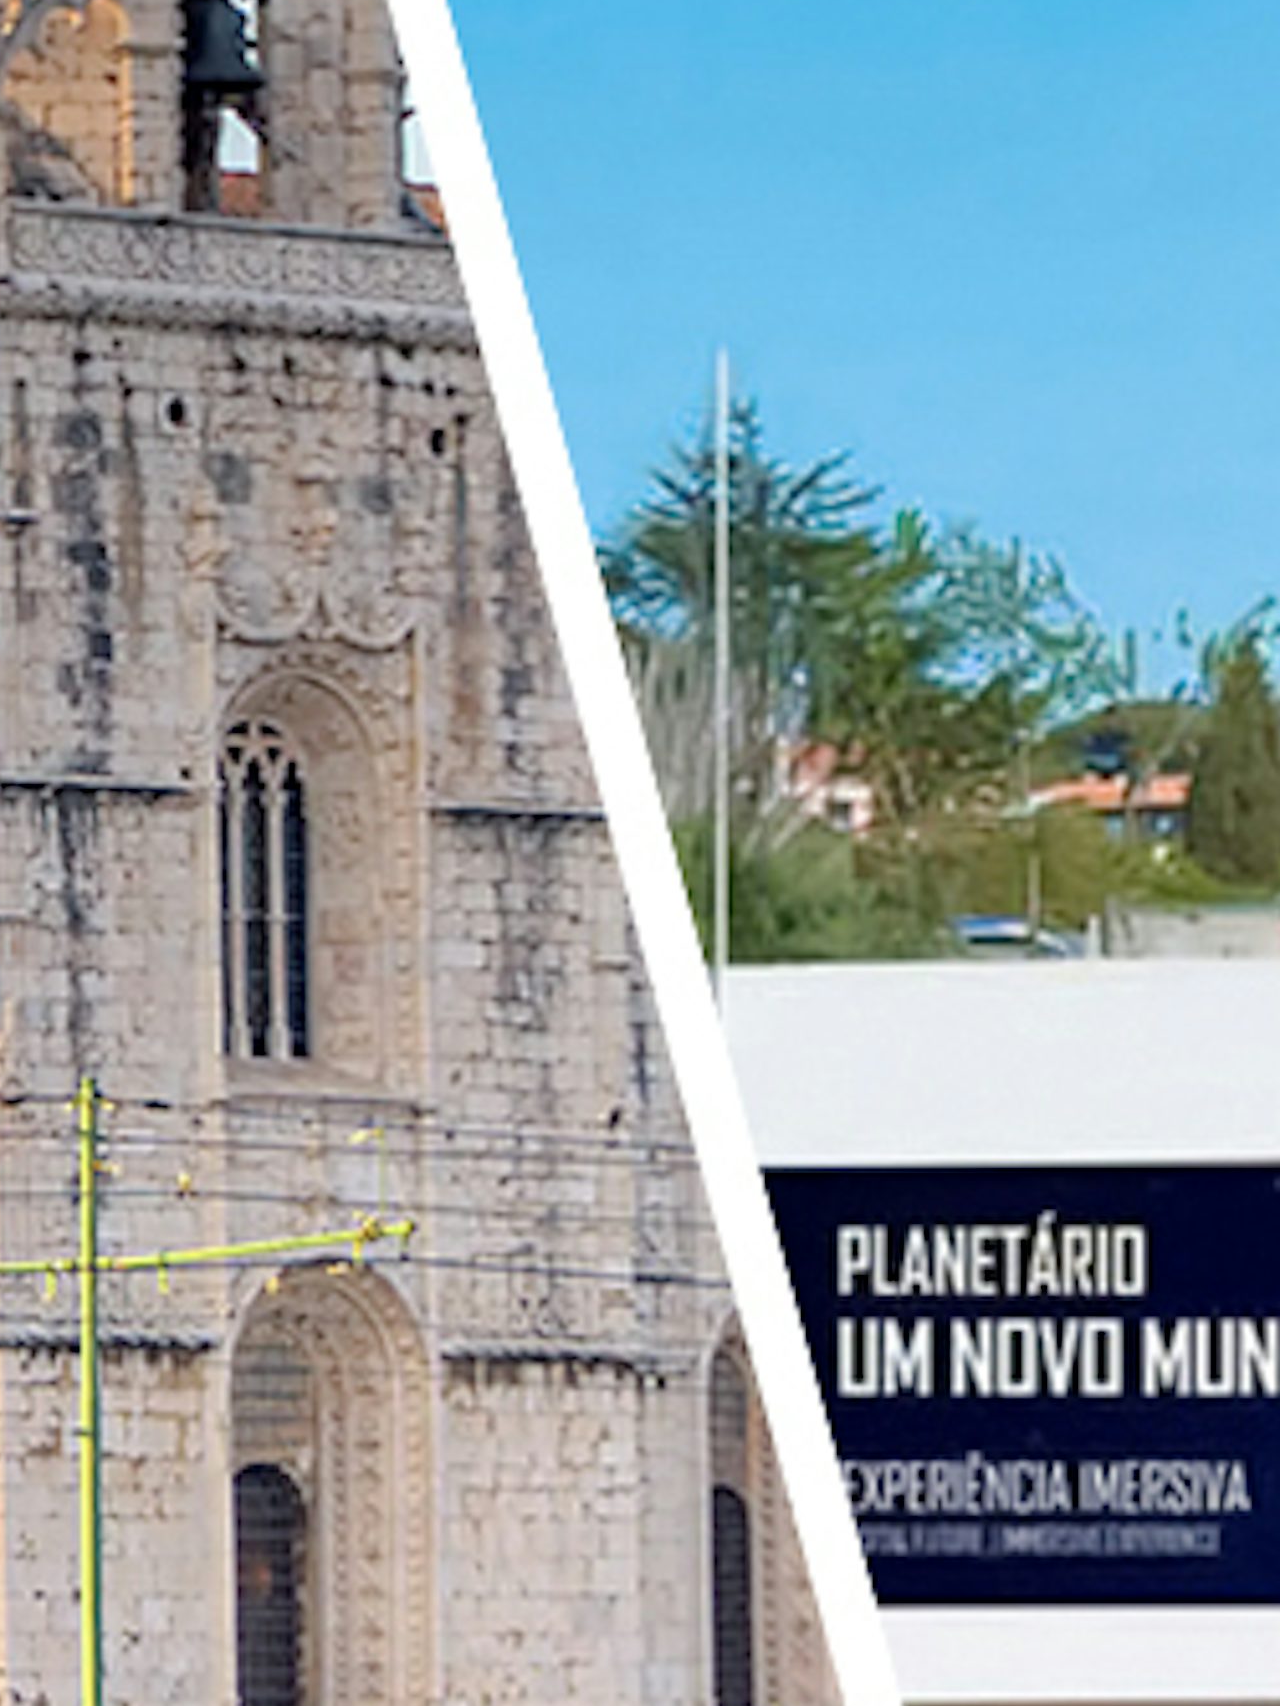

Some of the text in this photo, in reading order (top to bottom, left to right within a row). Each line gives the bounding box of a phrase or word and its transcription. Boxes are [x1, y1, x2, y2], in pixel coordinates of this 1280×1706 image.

[837, 1210, 1146, 1297] PLANETÁRIO
[837, 1317, 932, 1398] UM
[951, 1317, 1123, 1398] NOVO
[843, 1450, 1252, 1514] EXPERIÊNCIA IMERSIVA
